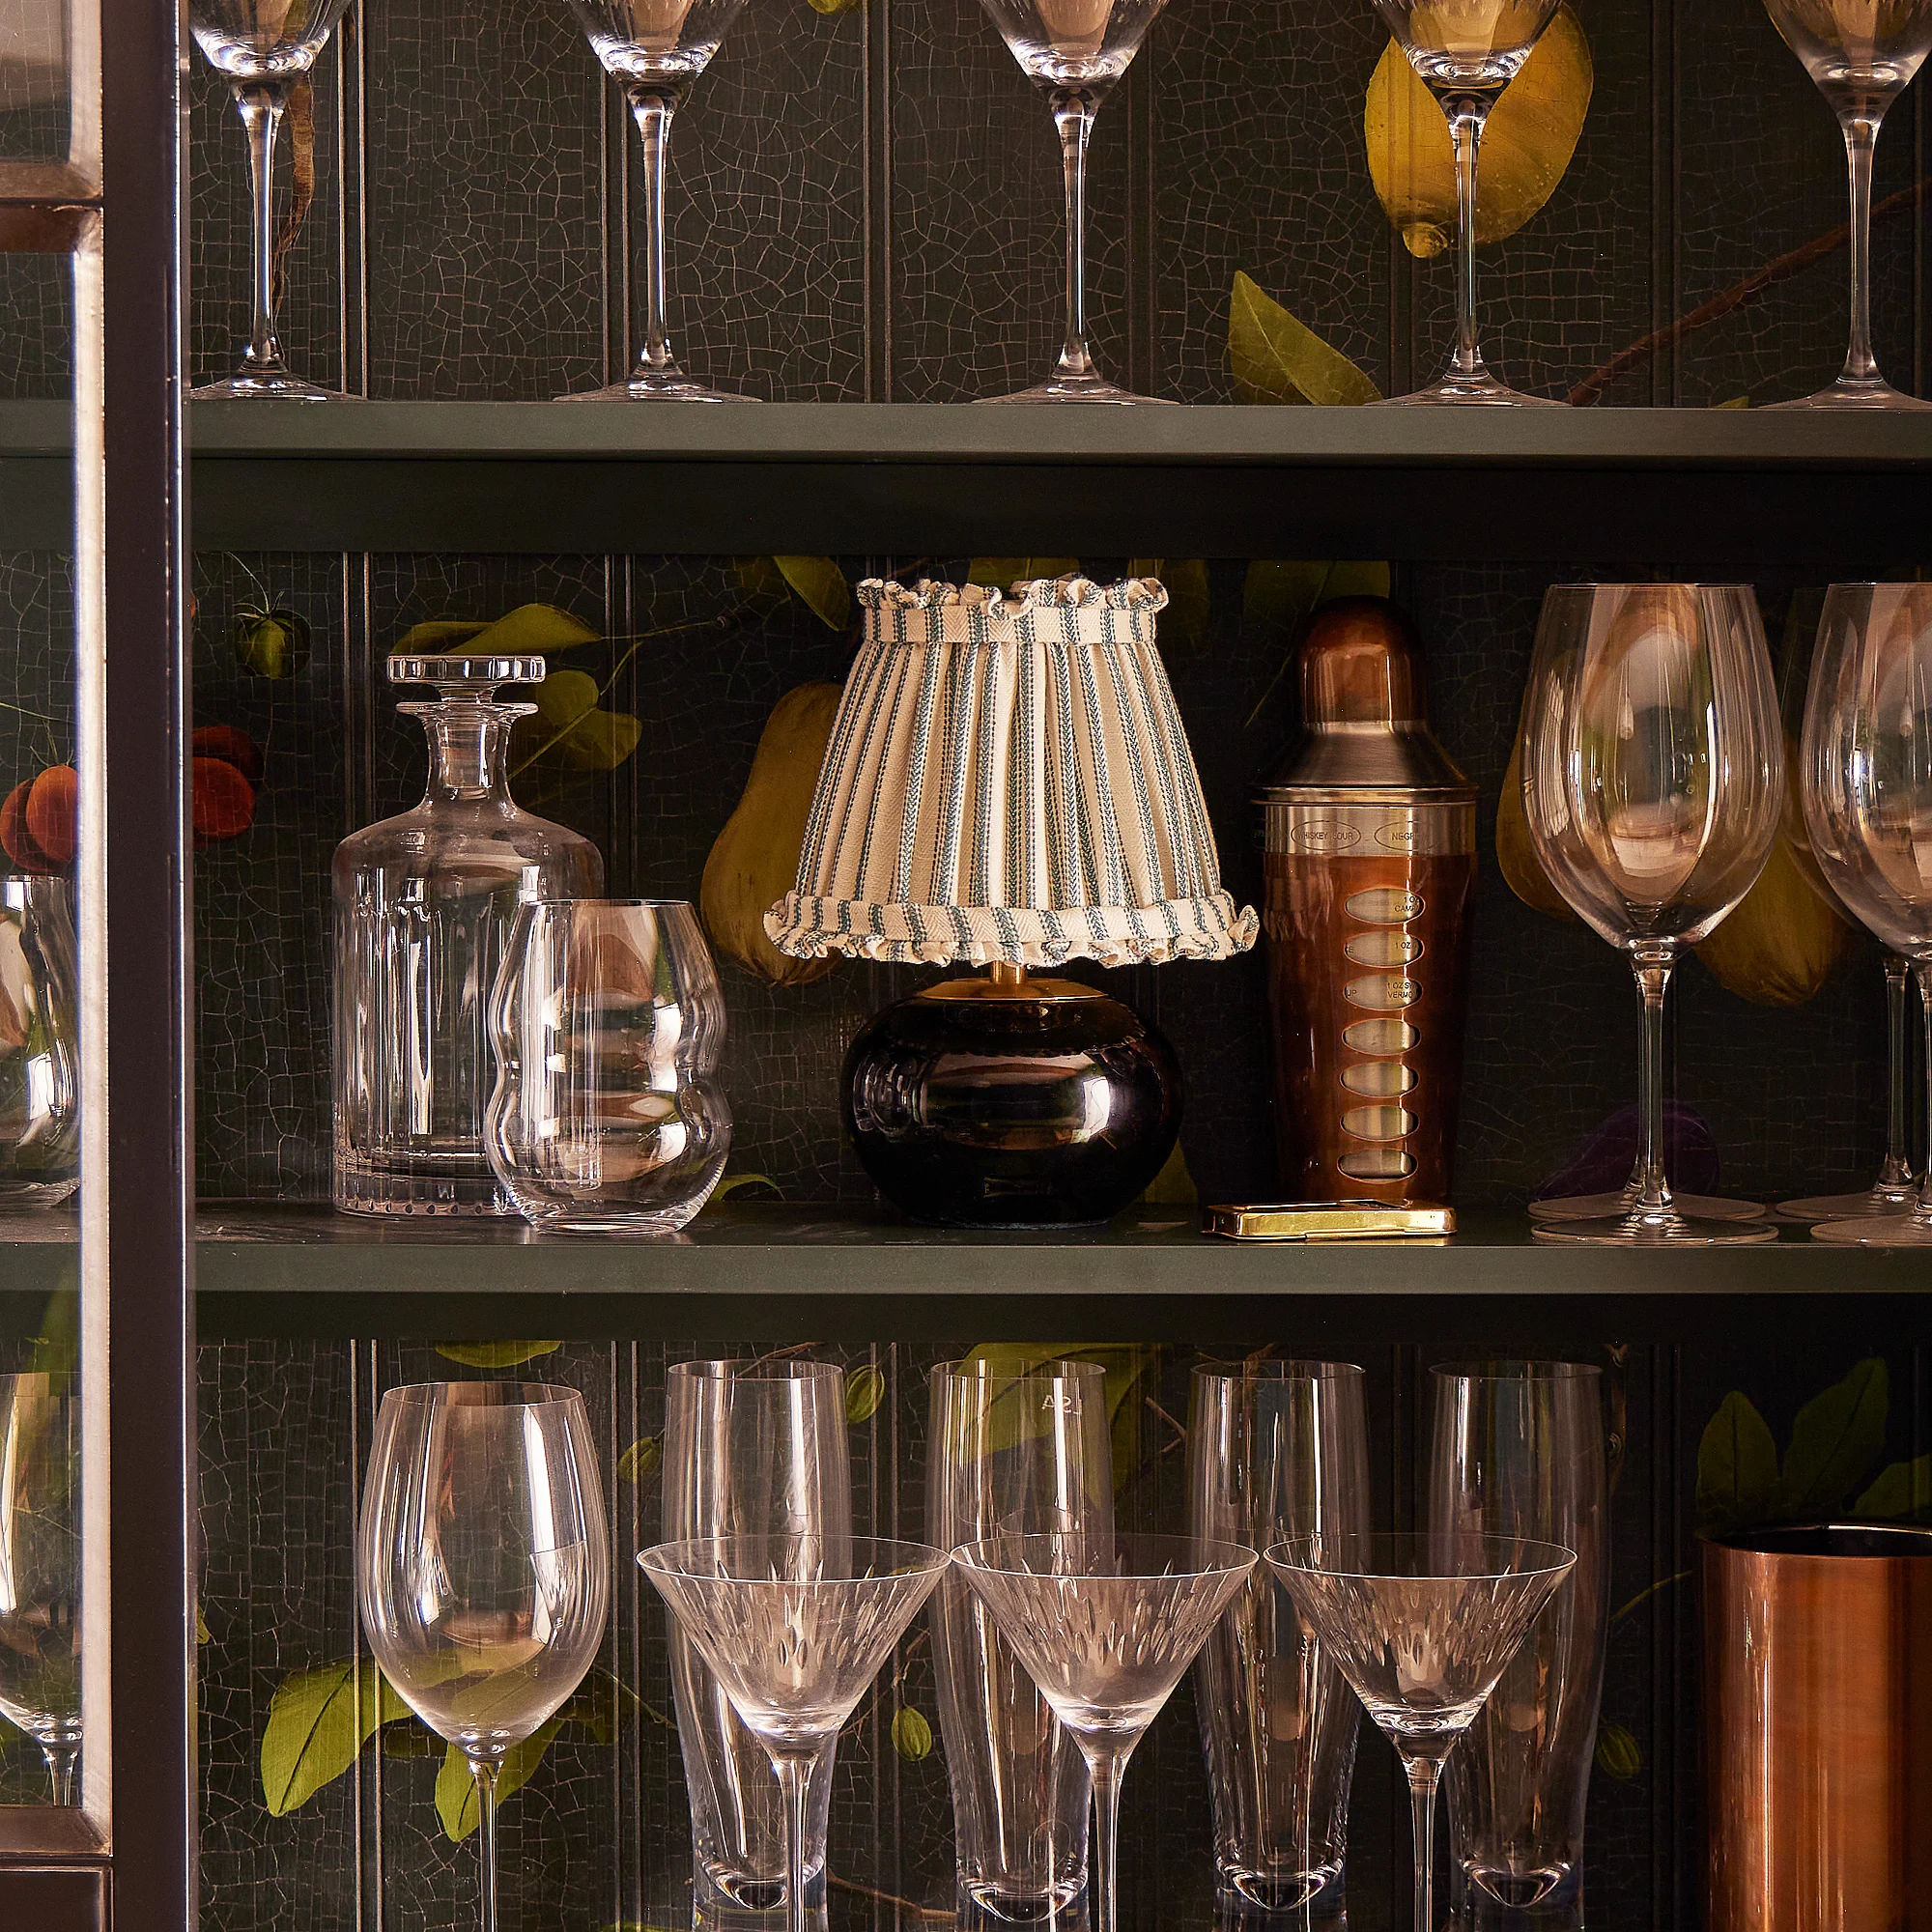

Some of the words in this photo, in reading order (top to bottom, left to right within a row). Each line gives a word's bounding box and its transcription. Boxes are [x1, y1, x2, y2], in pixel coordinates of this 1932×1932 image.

[1296, 832, 1328, 840] WHISKEY
[1332, 832, 1354, 840] SOUR
[1400, 941, 1411, 950] OZ
